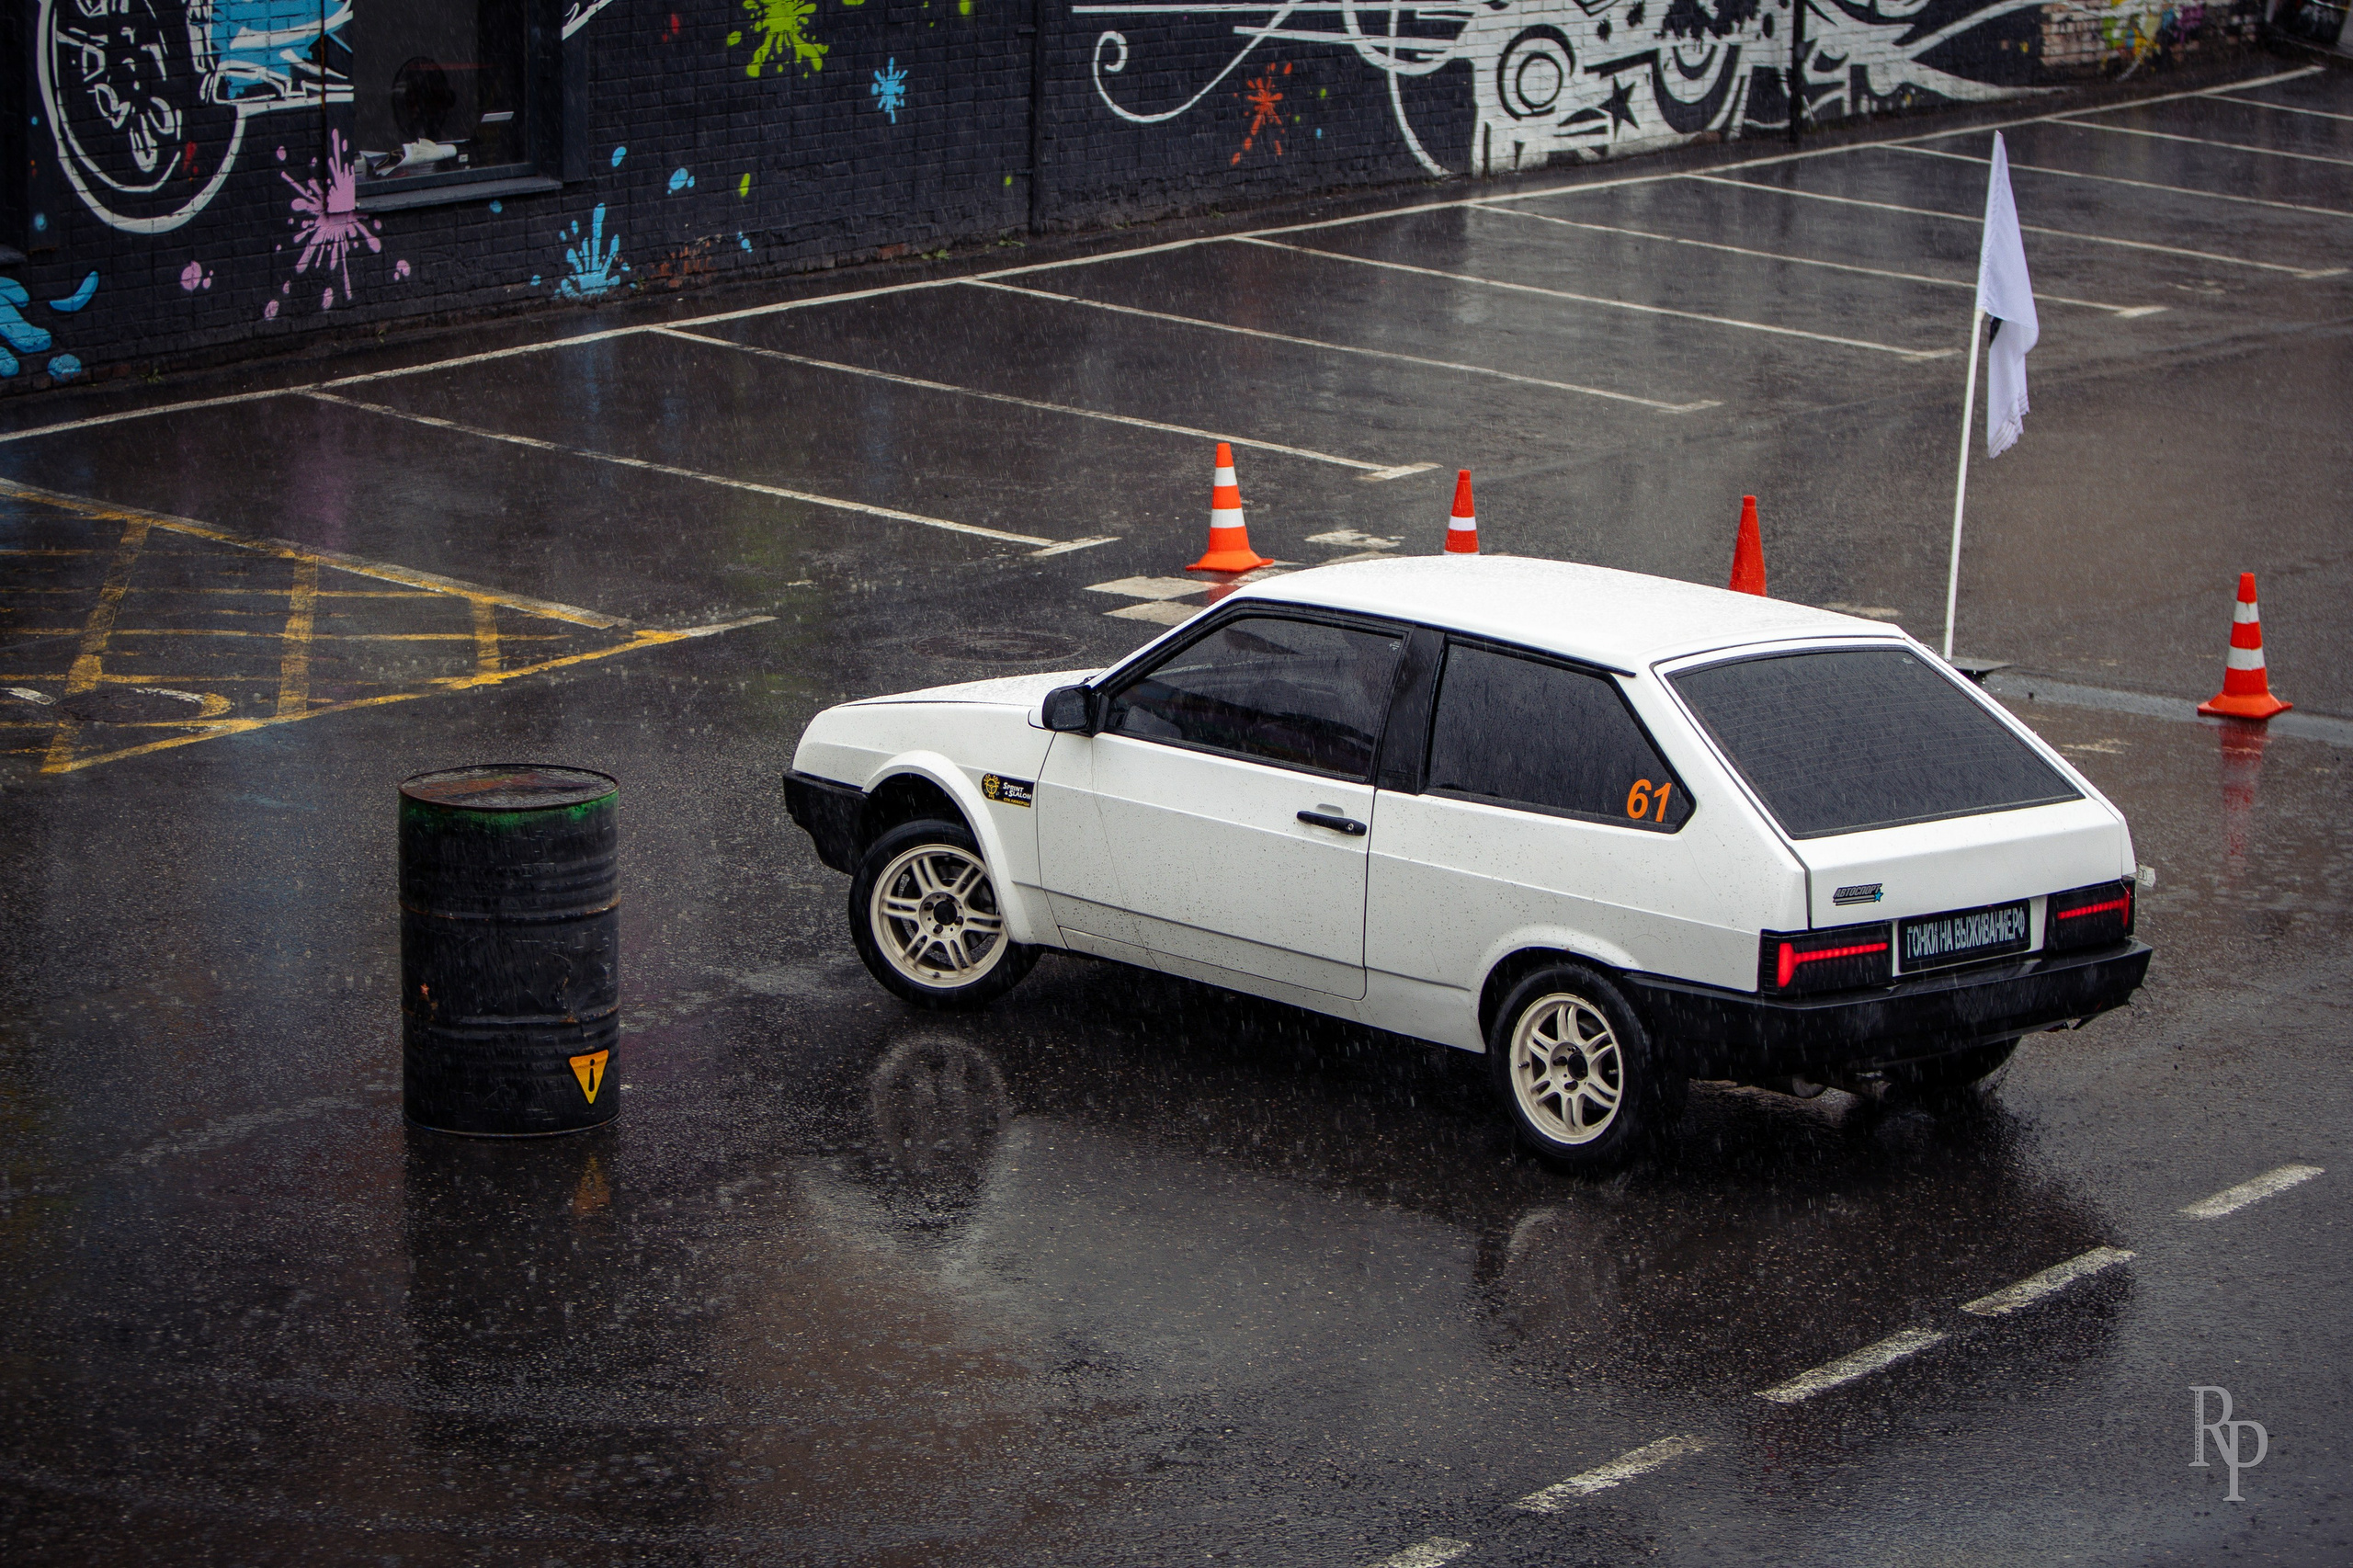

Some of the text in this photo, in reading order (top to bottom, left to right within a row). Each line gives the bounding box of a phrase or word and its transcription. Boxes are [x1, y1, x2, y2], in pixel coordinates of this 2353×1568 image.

[1627, 778, 1672, 823] 61
[1834, 885, 1881, 898] АВТОСПОРТ
[1906, 906, 2026, 959] ГОНКИ НА ВЫЖИВАНИЕ.РФ
